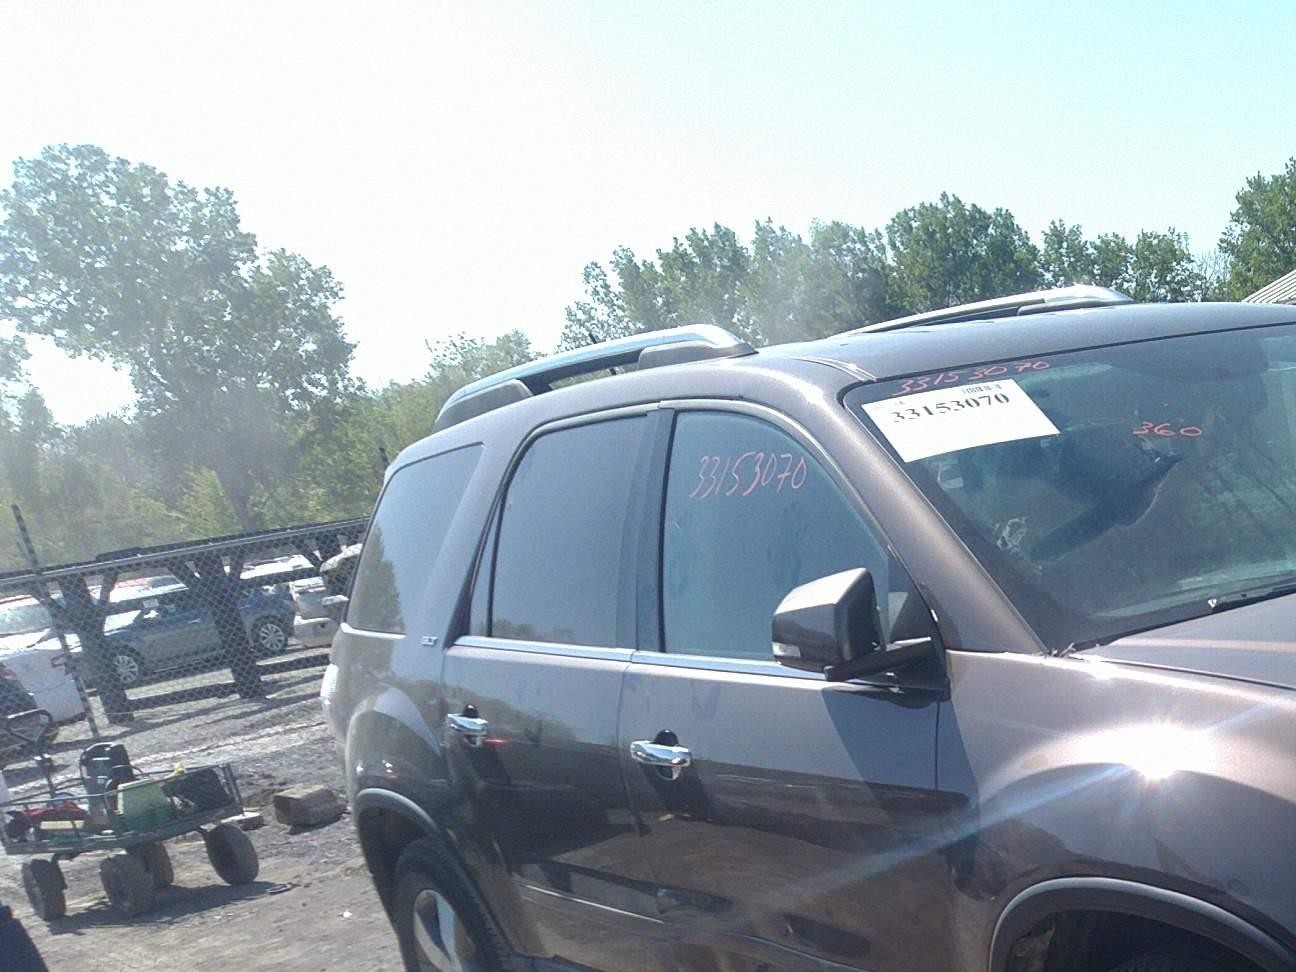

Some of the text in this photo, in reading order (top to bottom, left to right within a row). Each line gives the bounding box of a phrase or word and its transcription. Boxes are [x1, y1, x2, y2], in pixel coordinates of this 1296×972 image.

[891, 393, 1010, 422] 33153070
[1132, 421, 1202, 436] 360
[689, 451, 807, 498] 33153070
